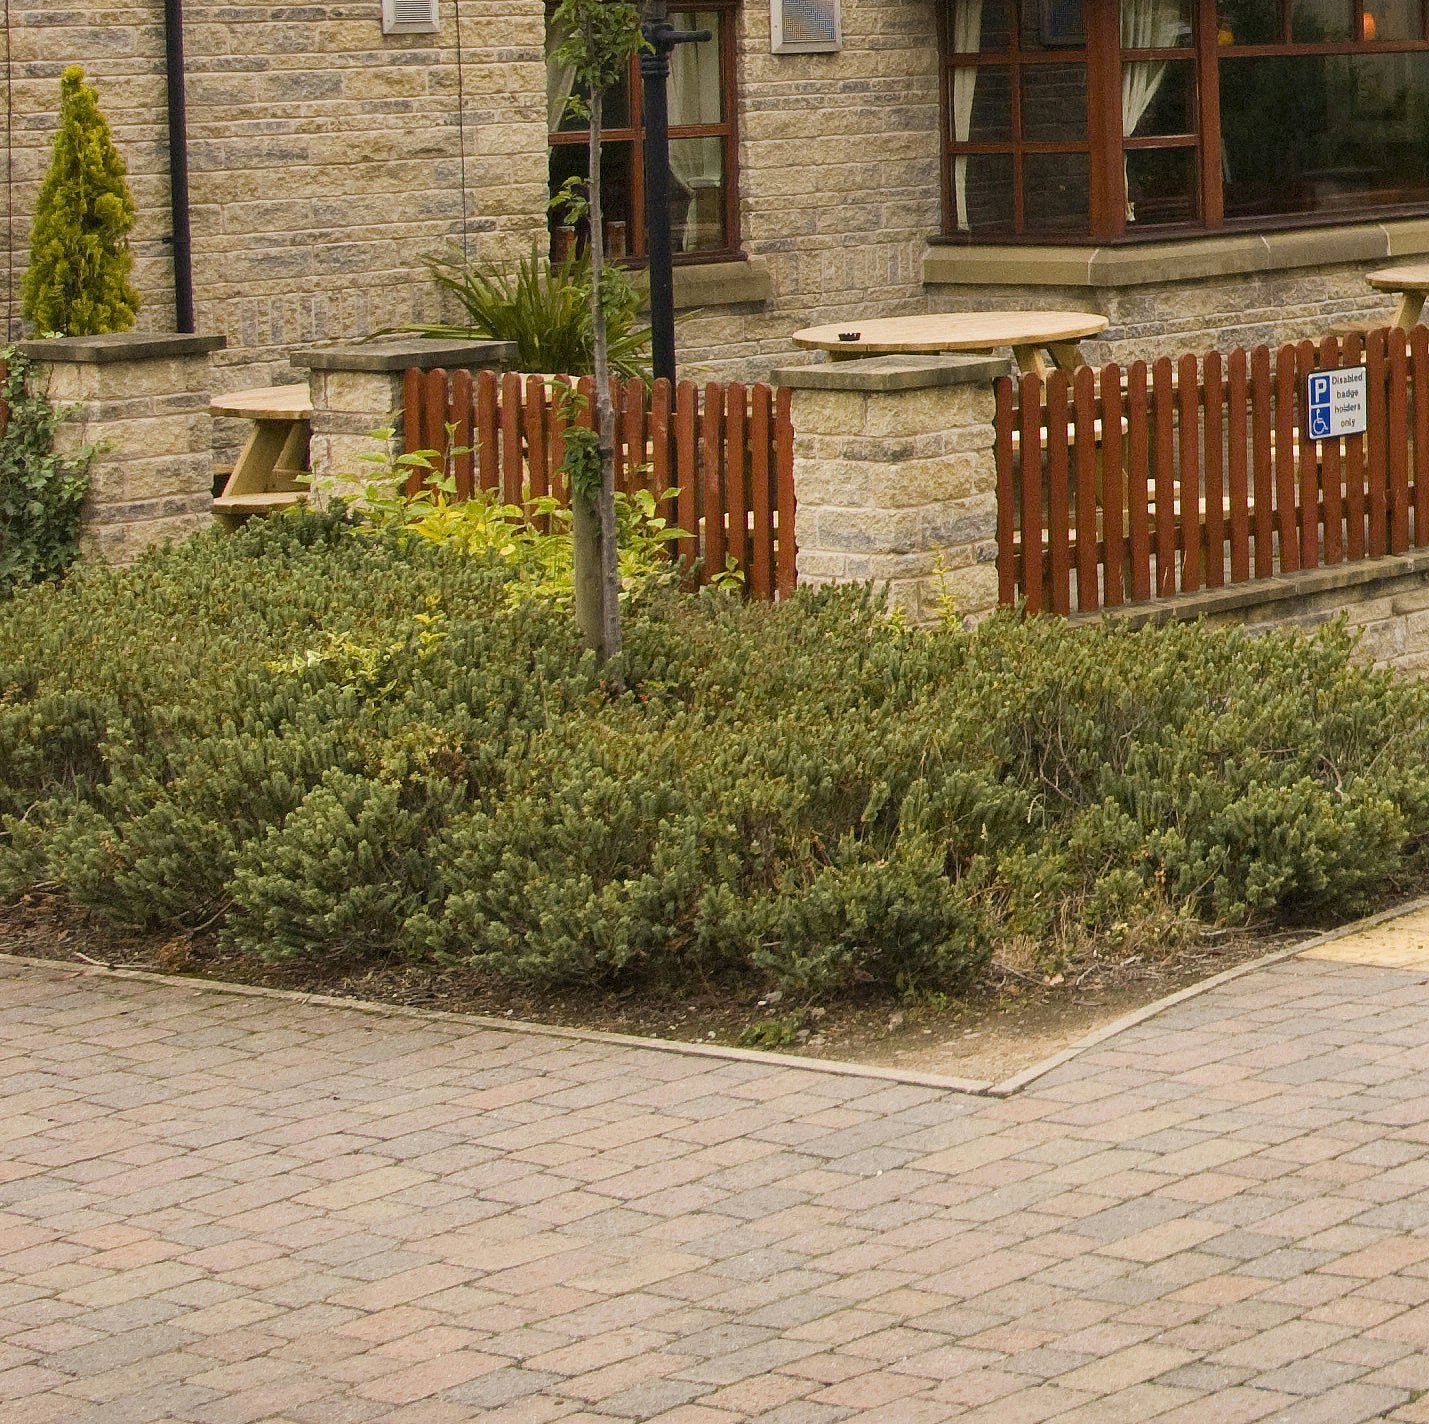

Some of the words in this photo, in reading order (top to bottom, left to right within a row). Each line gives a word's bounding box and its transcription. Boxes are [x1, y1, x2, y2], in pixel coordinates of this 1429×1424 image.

[1331, 373, 1363, 385] Disabled
[1314, 378, 1327, 403] P
[1336, 390, 1358, 399] badge
[1334, 403, 1361, 414] holders
[1340, 418, 1356, 428] only
